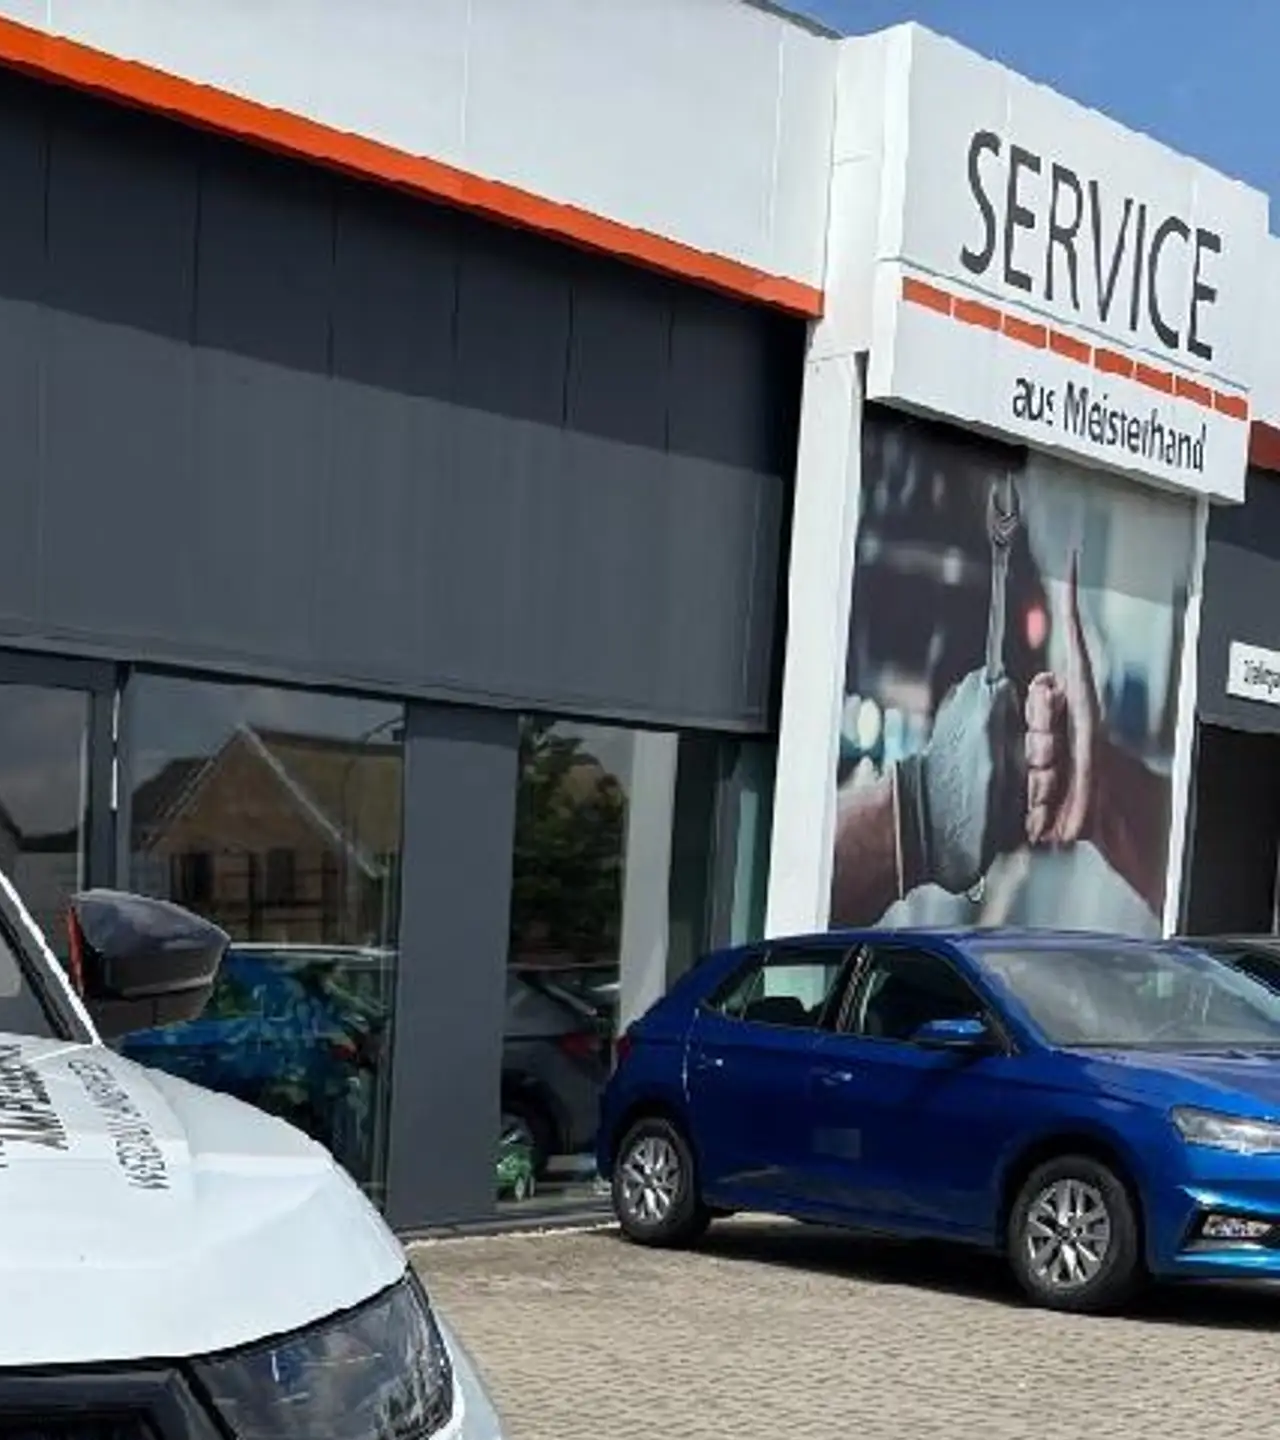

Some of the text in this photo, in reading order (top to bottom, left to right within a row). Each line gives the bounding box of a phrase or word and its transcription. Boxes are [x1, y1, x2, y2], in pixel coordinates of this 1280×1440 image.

[960, 129, 1222, 361] SERVICE
[1013, 375, 1208, 472] aus Meisterhand
